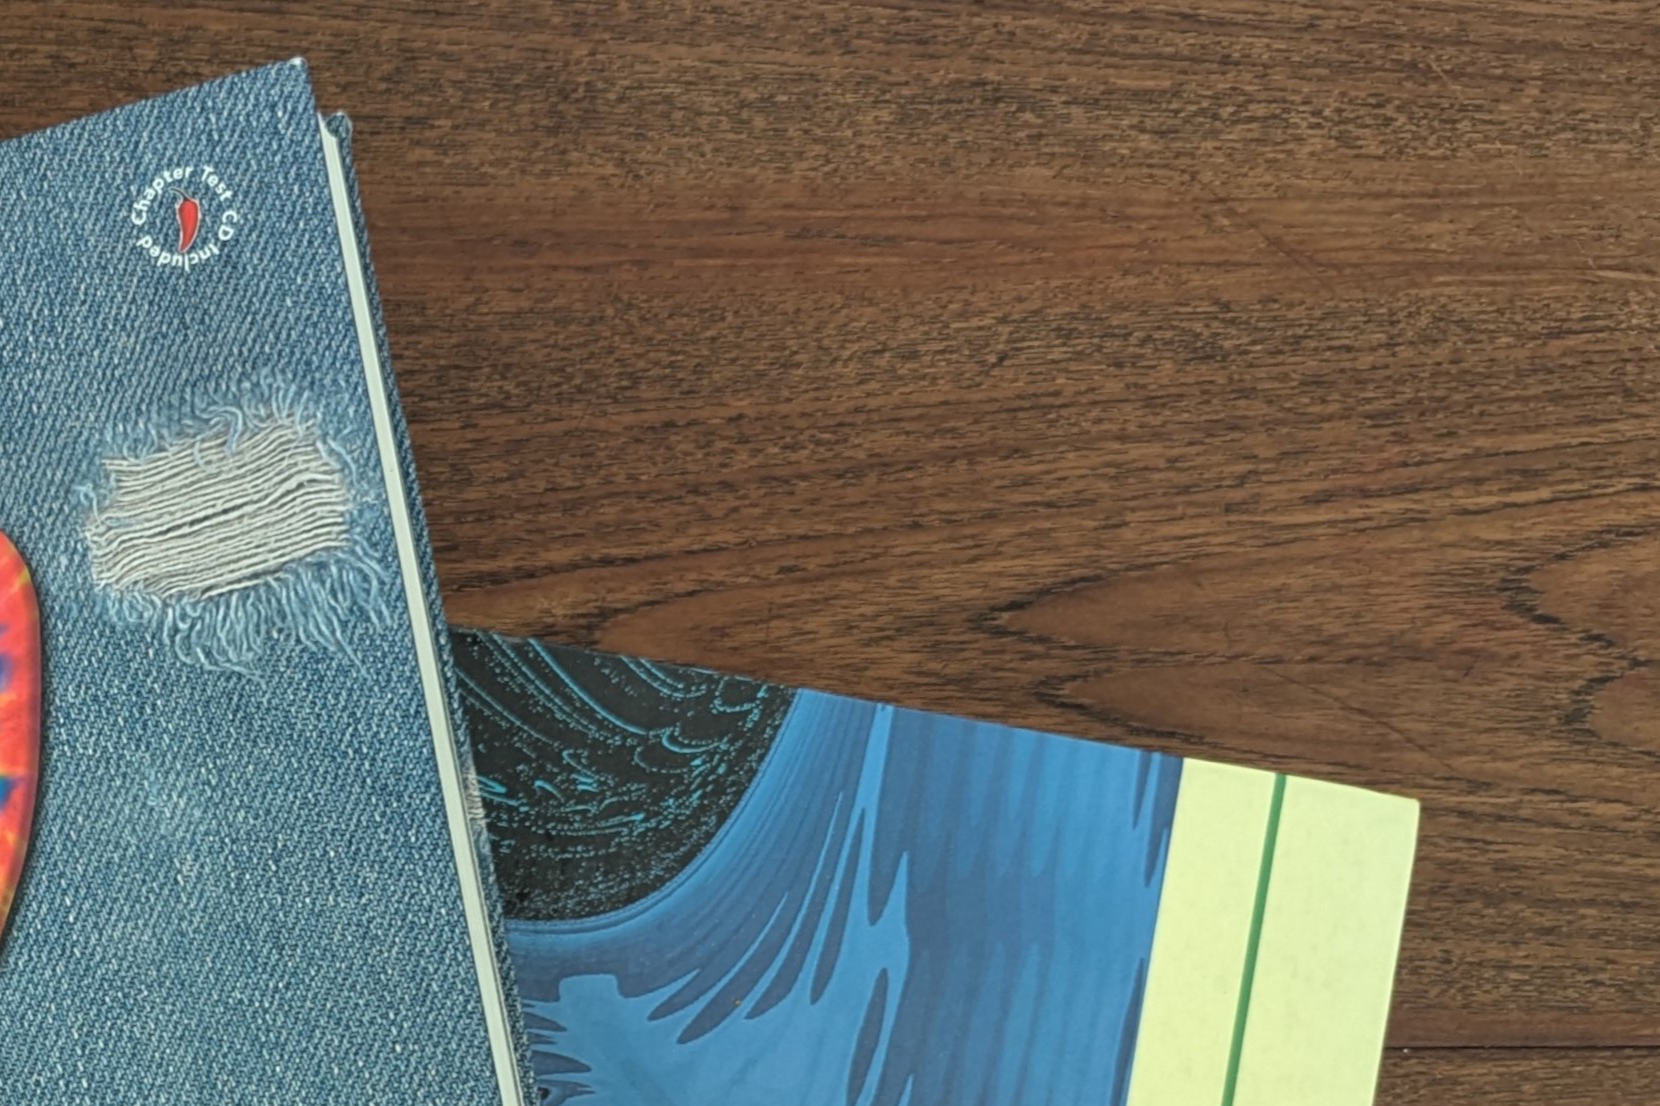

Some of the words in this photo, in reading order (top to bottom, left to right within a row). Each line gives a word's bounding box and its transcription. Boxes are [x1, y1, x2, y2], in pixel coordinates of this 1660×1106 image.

[131, 166, 193, 225] Chapter
[201, 166, 233, 201] Test
[218, 210, 238, 241] CD
[136, 235, 220, 272] Included
